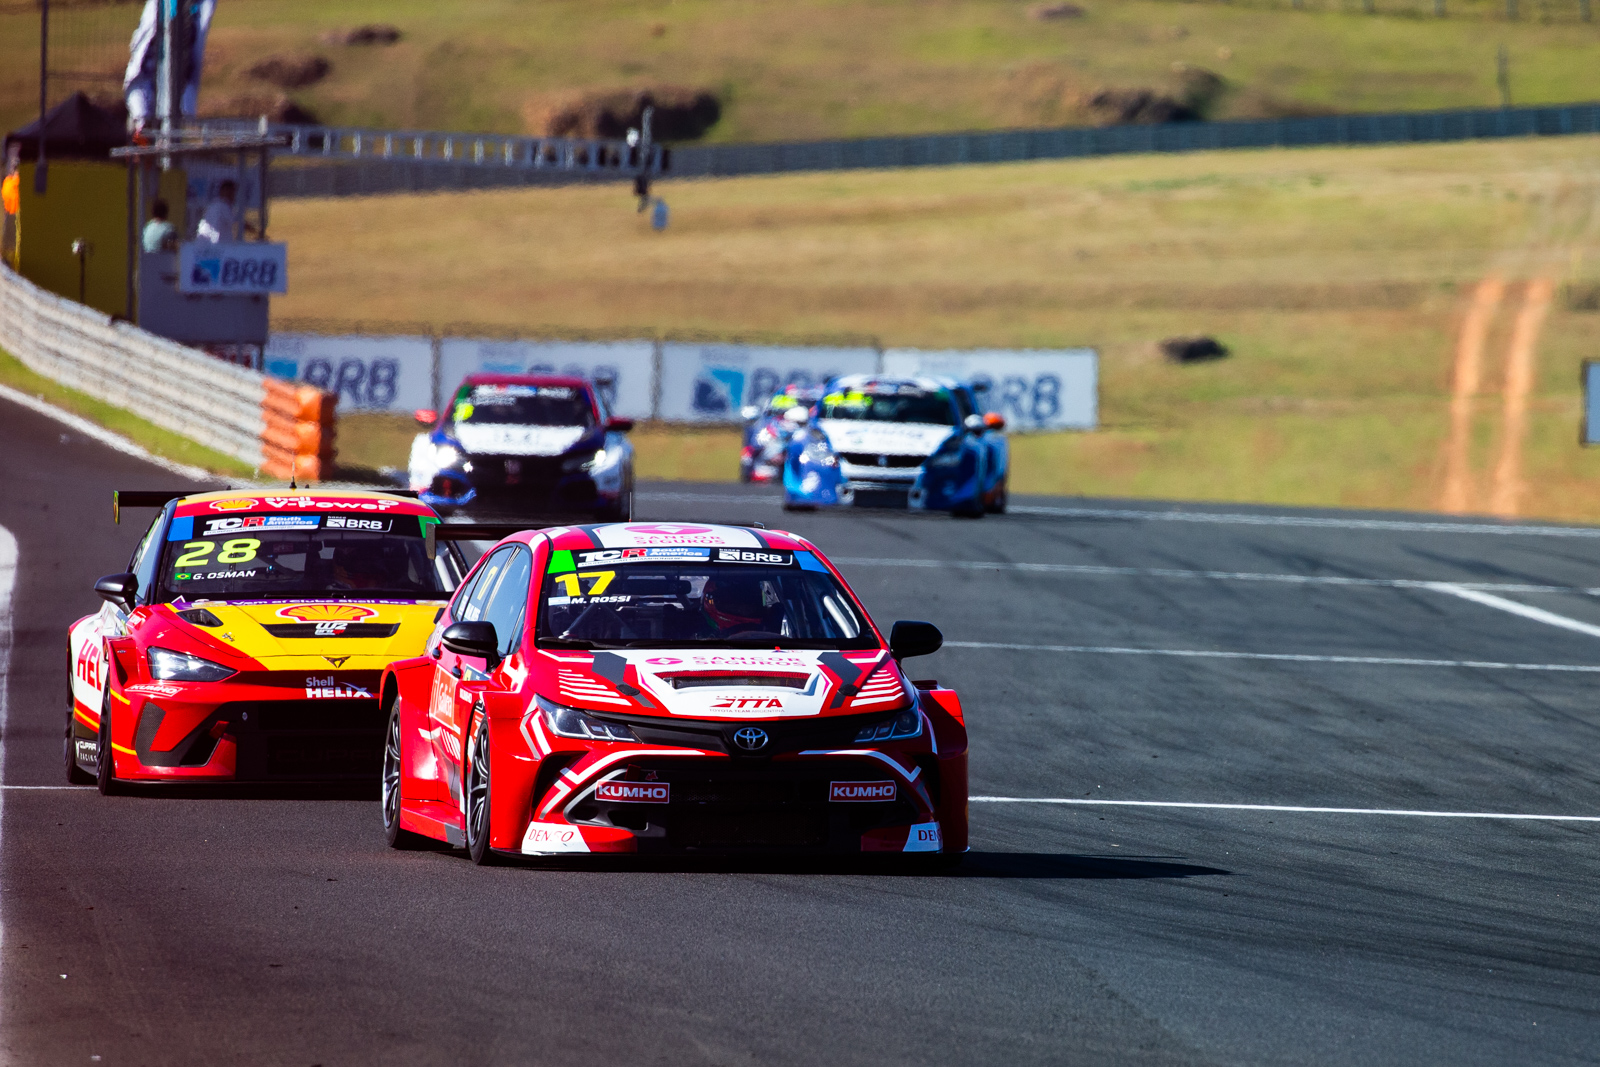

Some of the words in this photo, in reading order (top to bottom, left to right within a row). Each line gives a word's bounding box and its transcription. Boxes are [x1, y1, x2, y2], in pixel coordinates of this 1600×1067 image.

[221, 258, 278, 287] BRB
[266, 499, 391, 511] V-Power
[206, 517, 267, 531] TCR
[346, 519, 383, 530] BRB
[174, 538, 261, 568] 28
[579, 548, 648, 563] TCR
[741, 552, 783, 562] BRB
[206, 570, 257, 579] OSMAN
[554, 570, 616, 597] 17
[589, 595, 632, 604] ROSSI
[306, 676, 334, 687] Shell
[131, 684, 178, 694] KUMHO
[305, 687, 372, 698] HELIX
[598, 784, 667, 798] KUMHO
[833, 785, 894, 797] KUMHO
